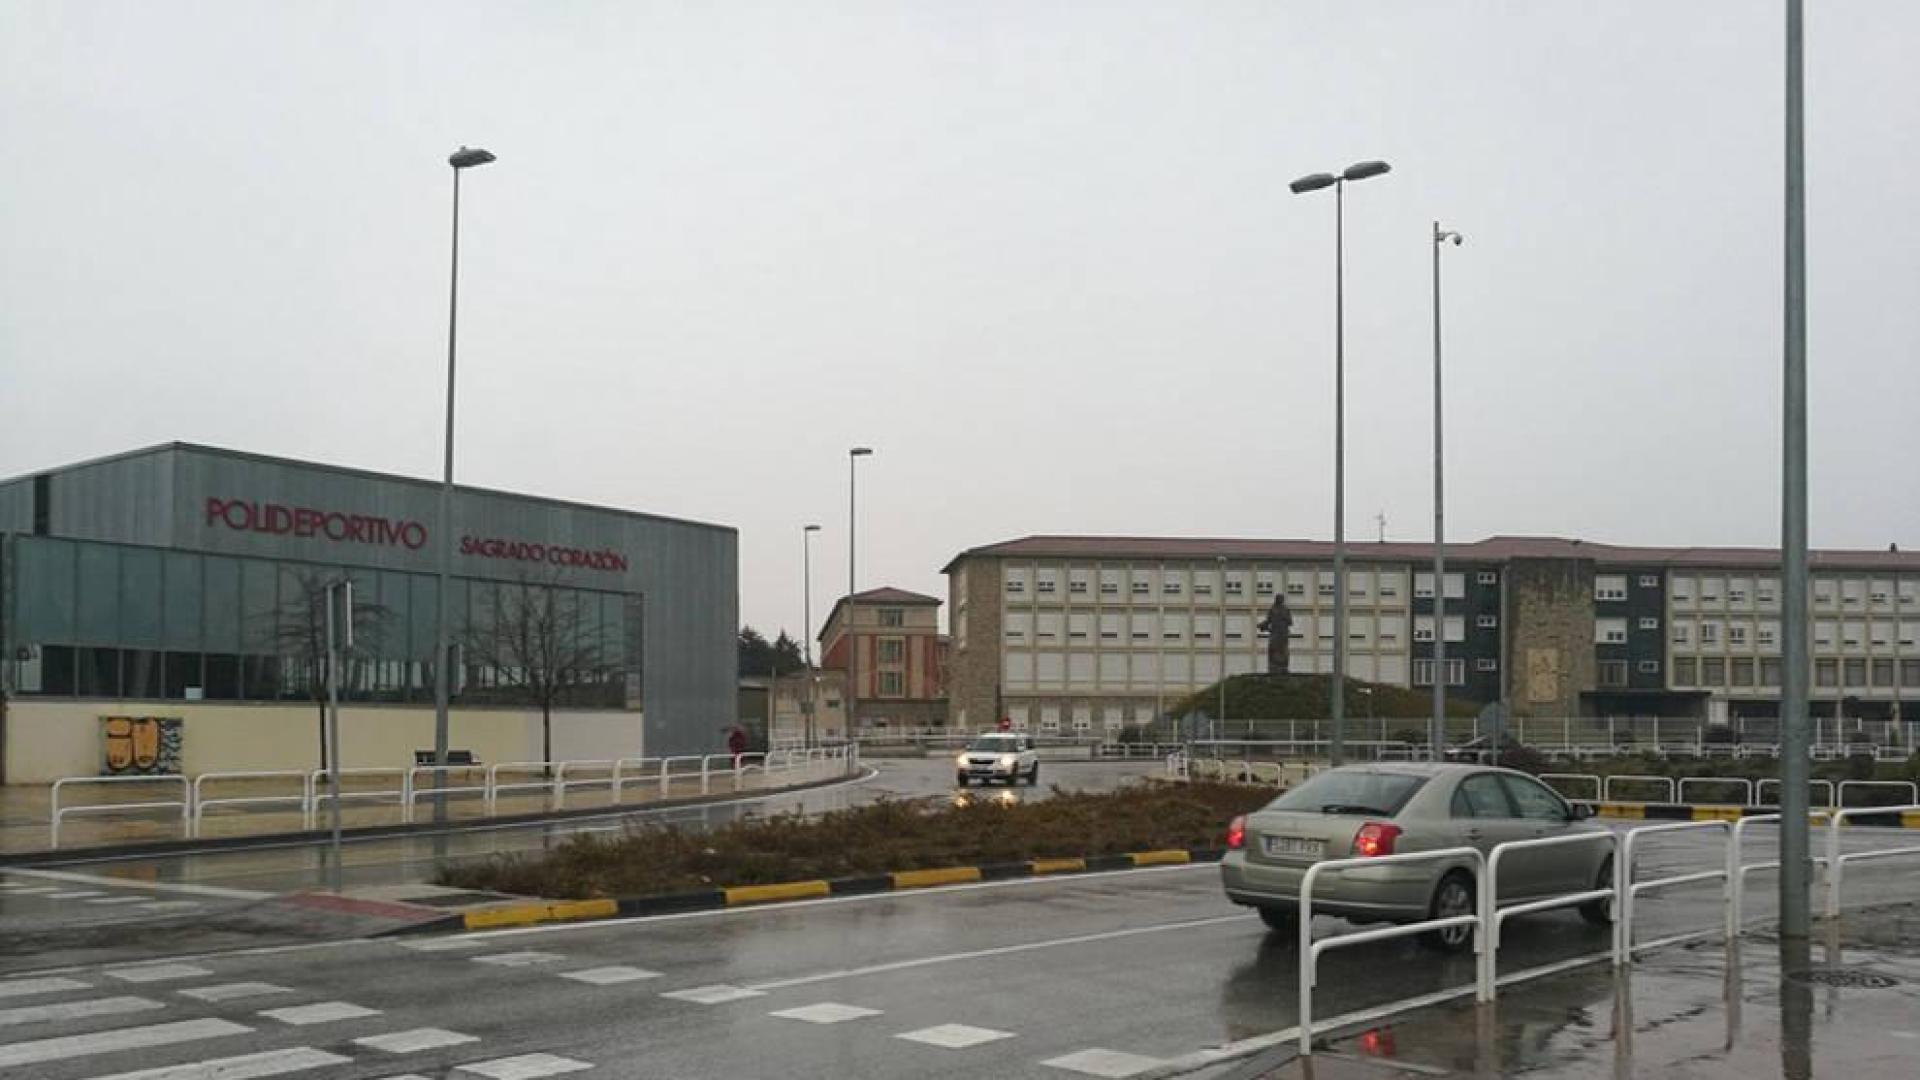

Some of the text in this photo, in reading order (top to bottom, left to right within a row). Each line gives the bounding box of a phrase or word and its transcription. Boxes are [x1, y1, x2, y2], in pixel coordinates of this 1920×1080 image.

[206, 498, 427, 549] POLIDEPORTIVO
[460, 535, 628, 572] SAGRADO CORAZÓN
